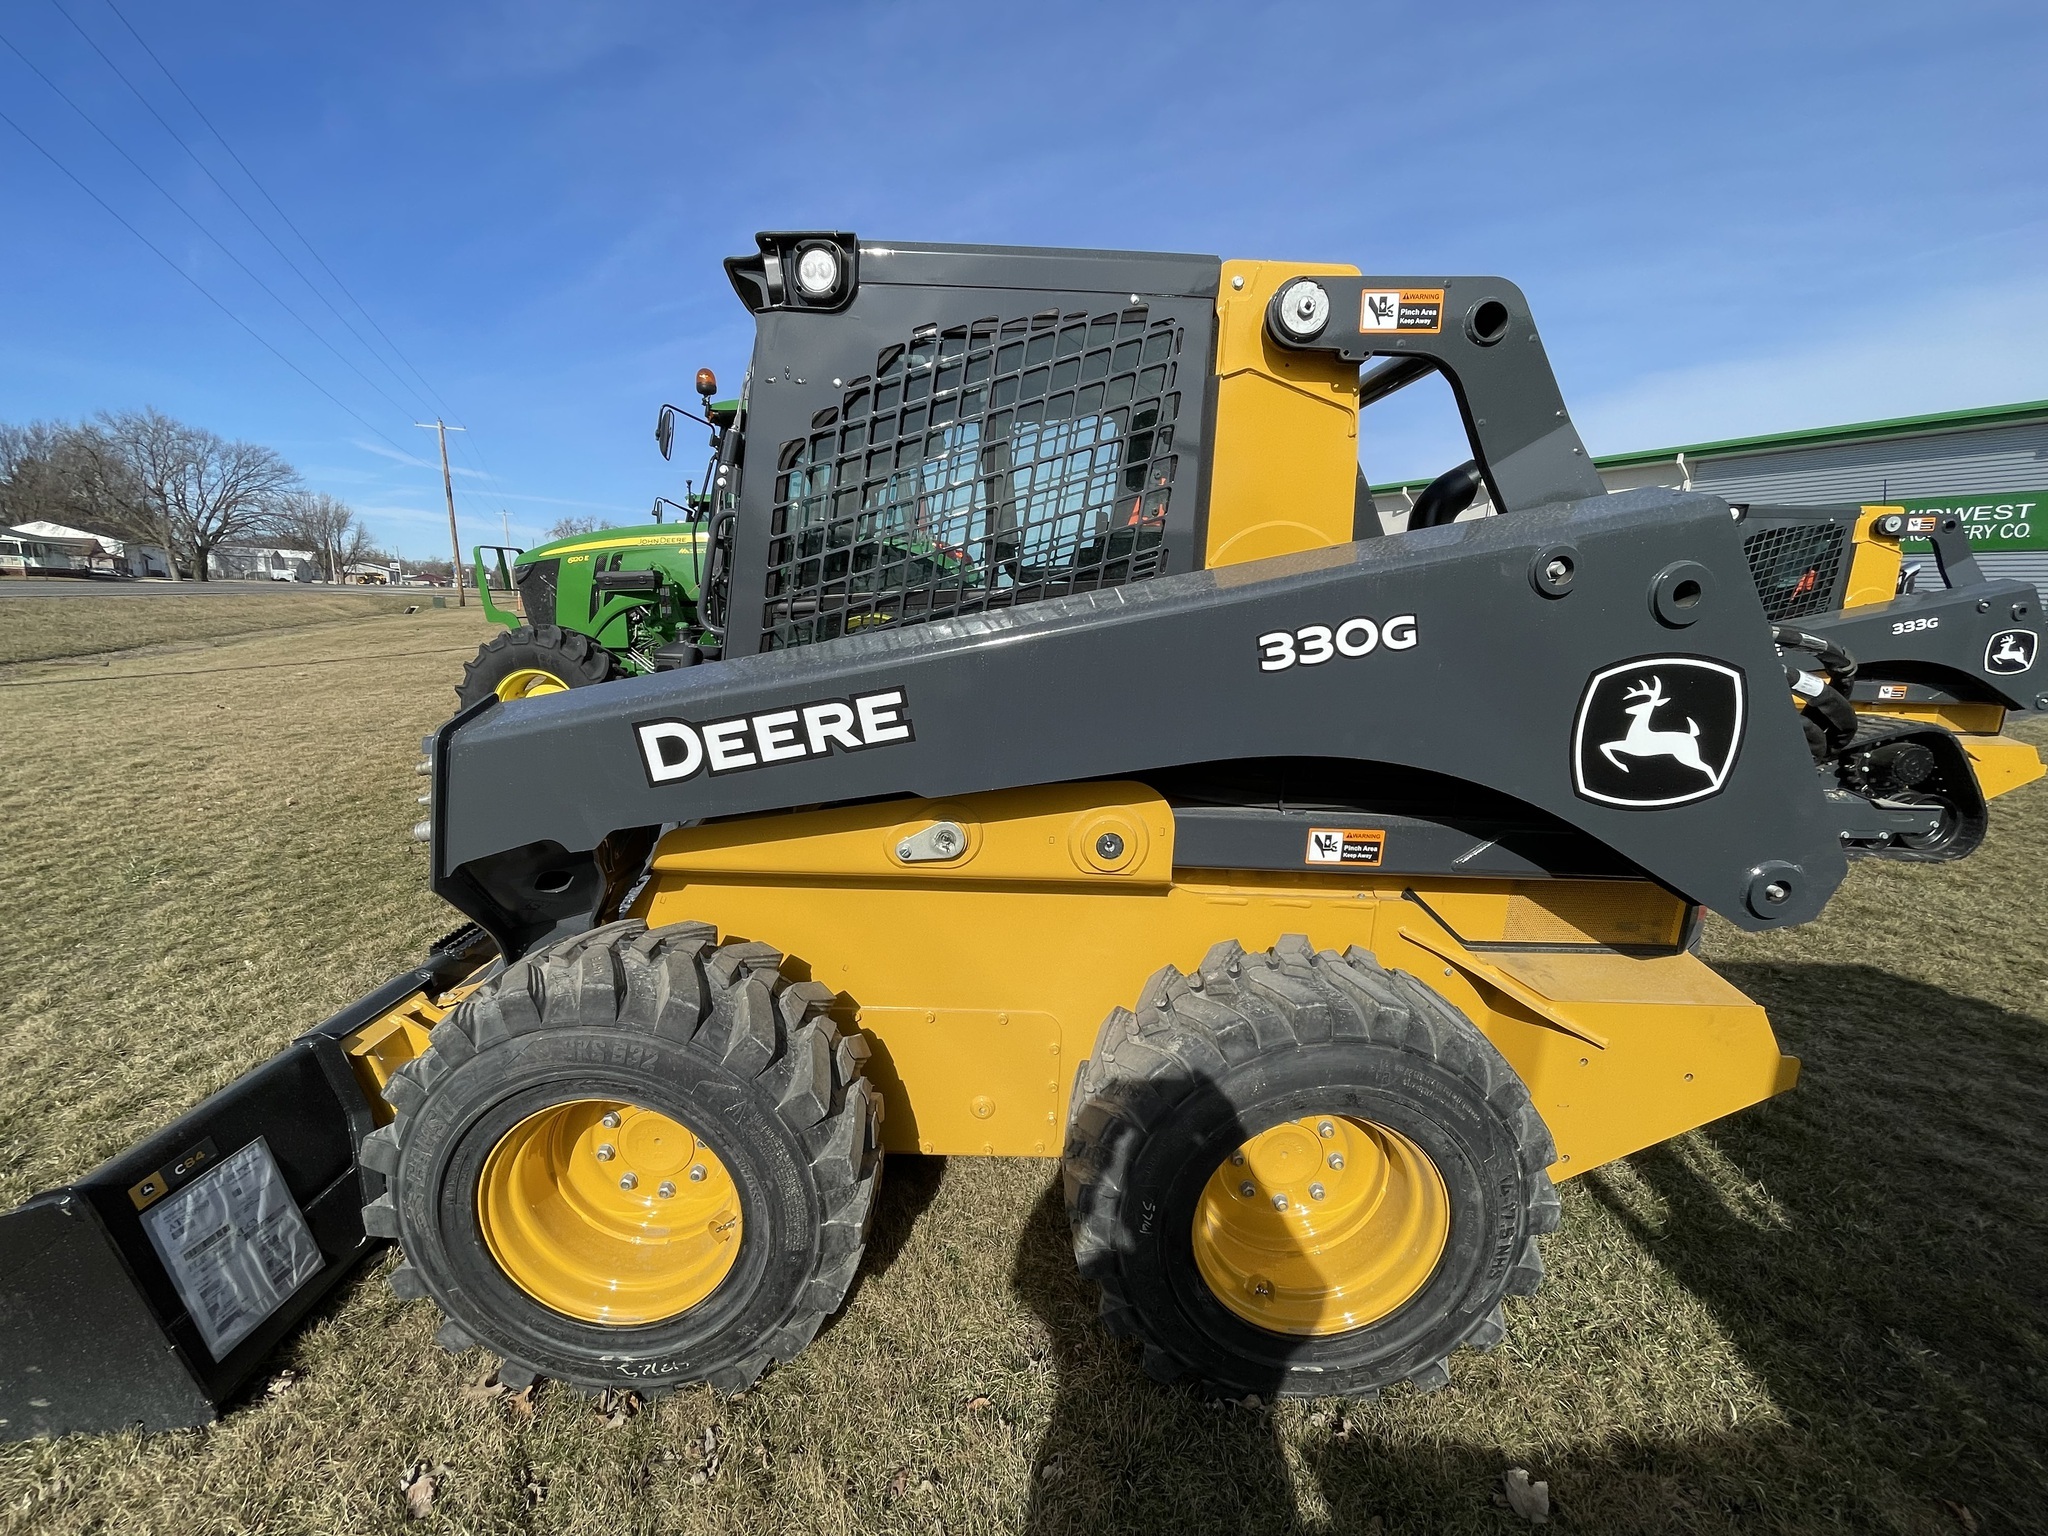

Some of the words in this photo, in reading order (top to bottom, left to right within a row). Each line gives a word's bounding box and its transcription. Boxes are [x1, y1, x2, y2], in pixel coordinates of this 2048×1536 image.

[1400, 308, 1420, 316] Pinch
[1421, 308, 1437, 316] Area
[1400, 317, 1414, 325] Keep
[1415, 317, 1431, 325] Away
[2000, 522, 2031, 539] CO.
[660, 536, 687, 544] DEERE
[1891, 617, 1939, 635] 333G
[1258, 614, 1419, 672] 330G
[638, 690, 910, 783] DEERE
[1343, 844, 1361, 852] Pinch
[1362, 844, 1378, 852] Area
[174, 1150, 206, 1175] C84
